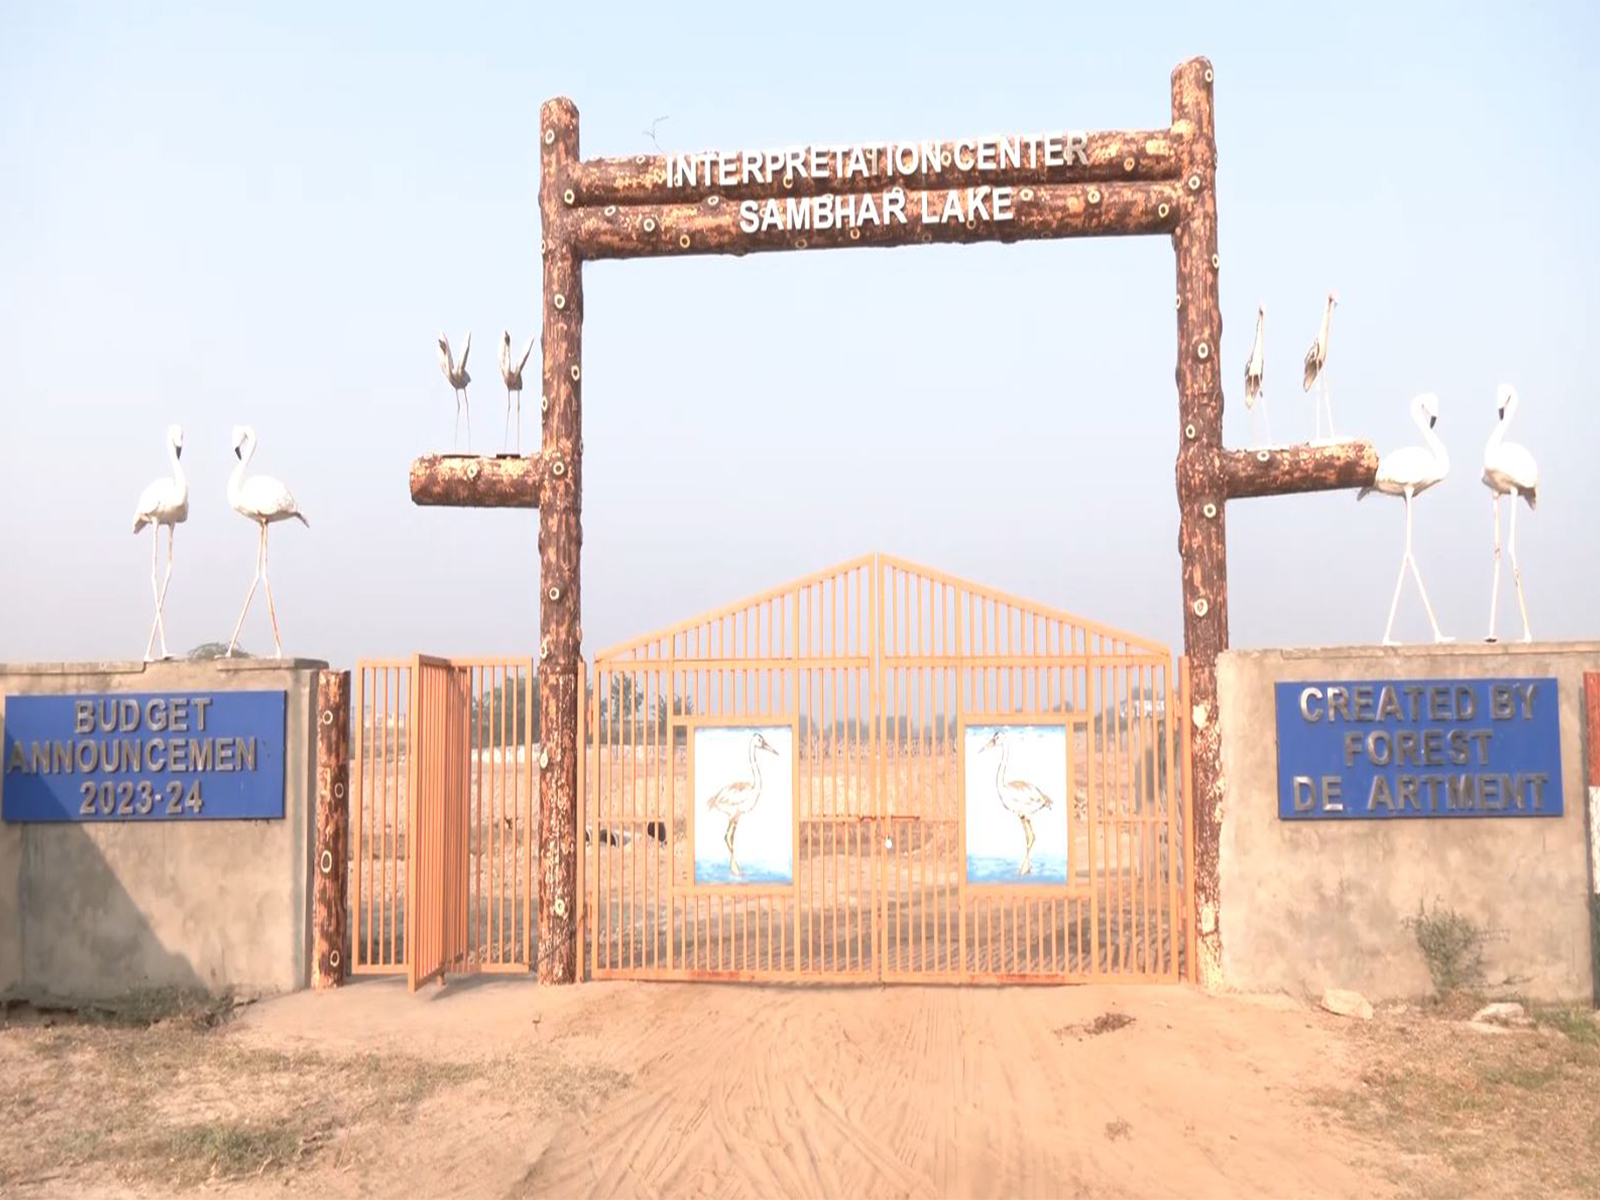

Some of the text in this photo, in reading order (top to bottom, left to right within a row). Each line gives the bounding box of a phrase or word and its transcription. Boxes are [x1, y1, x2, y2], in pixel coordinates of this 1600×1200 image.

[666, 131, 1089, 188] INTERPRETATION CENTER
[739, 187, 1014, 234] SAMBHAR LAKE
[75, 698, 212, 734] BUDGET
[1299, 683, 1538, 722] CREATED BY
[6, 737, 258, 774] ANNOUNCEMEN
[1344, 729, 1494, 766] FOREST
[79, 780, 204, 815] 2023-24
